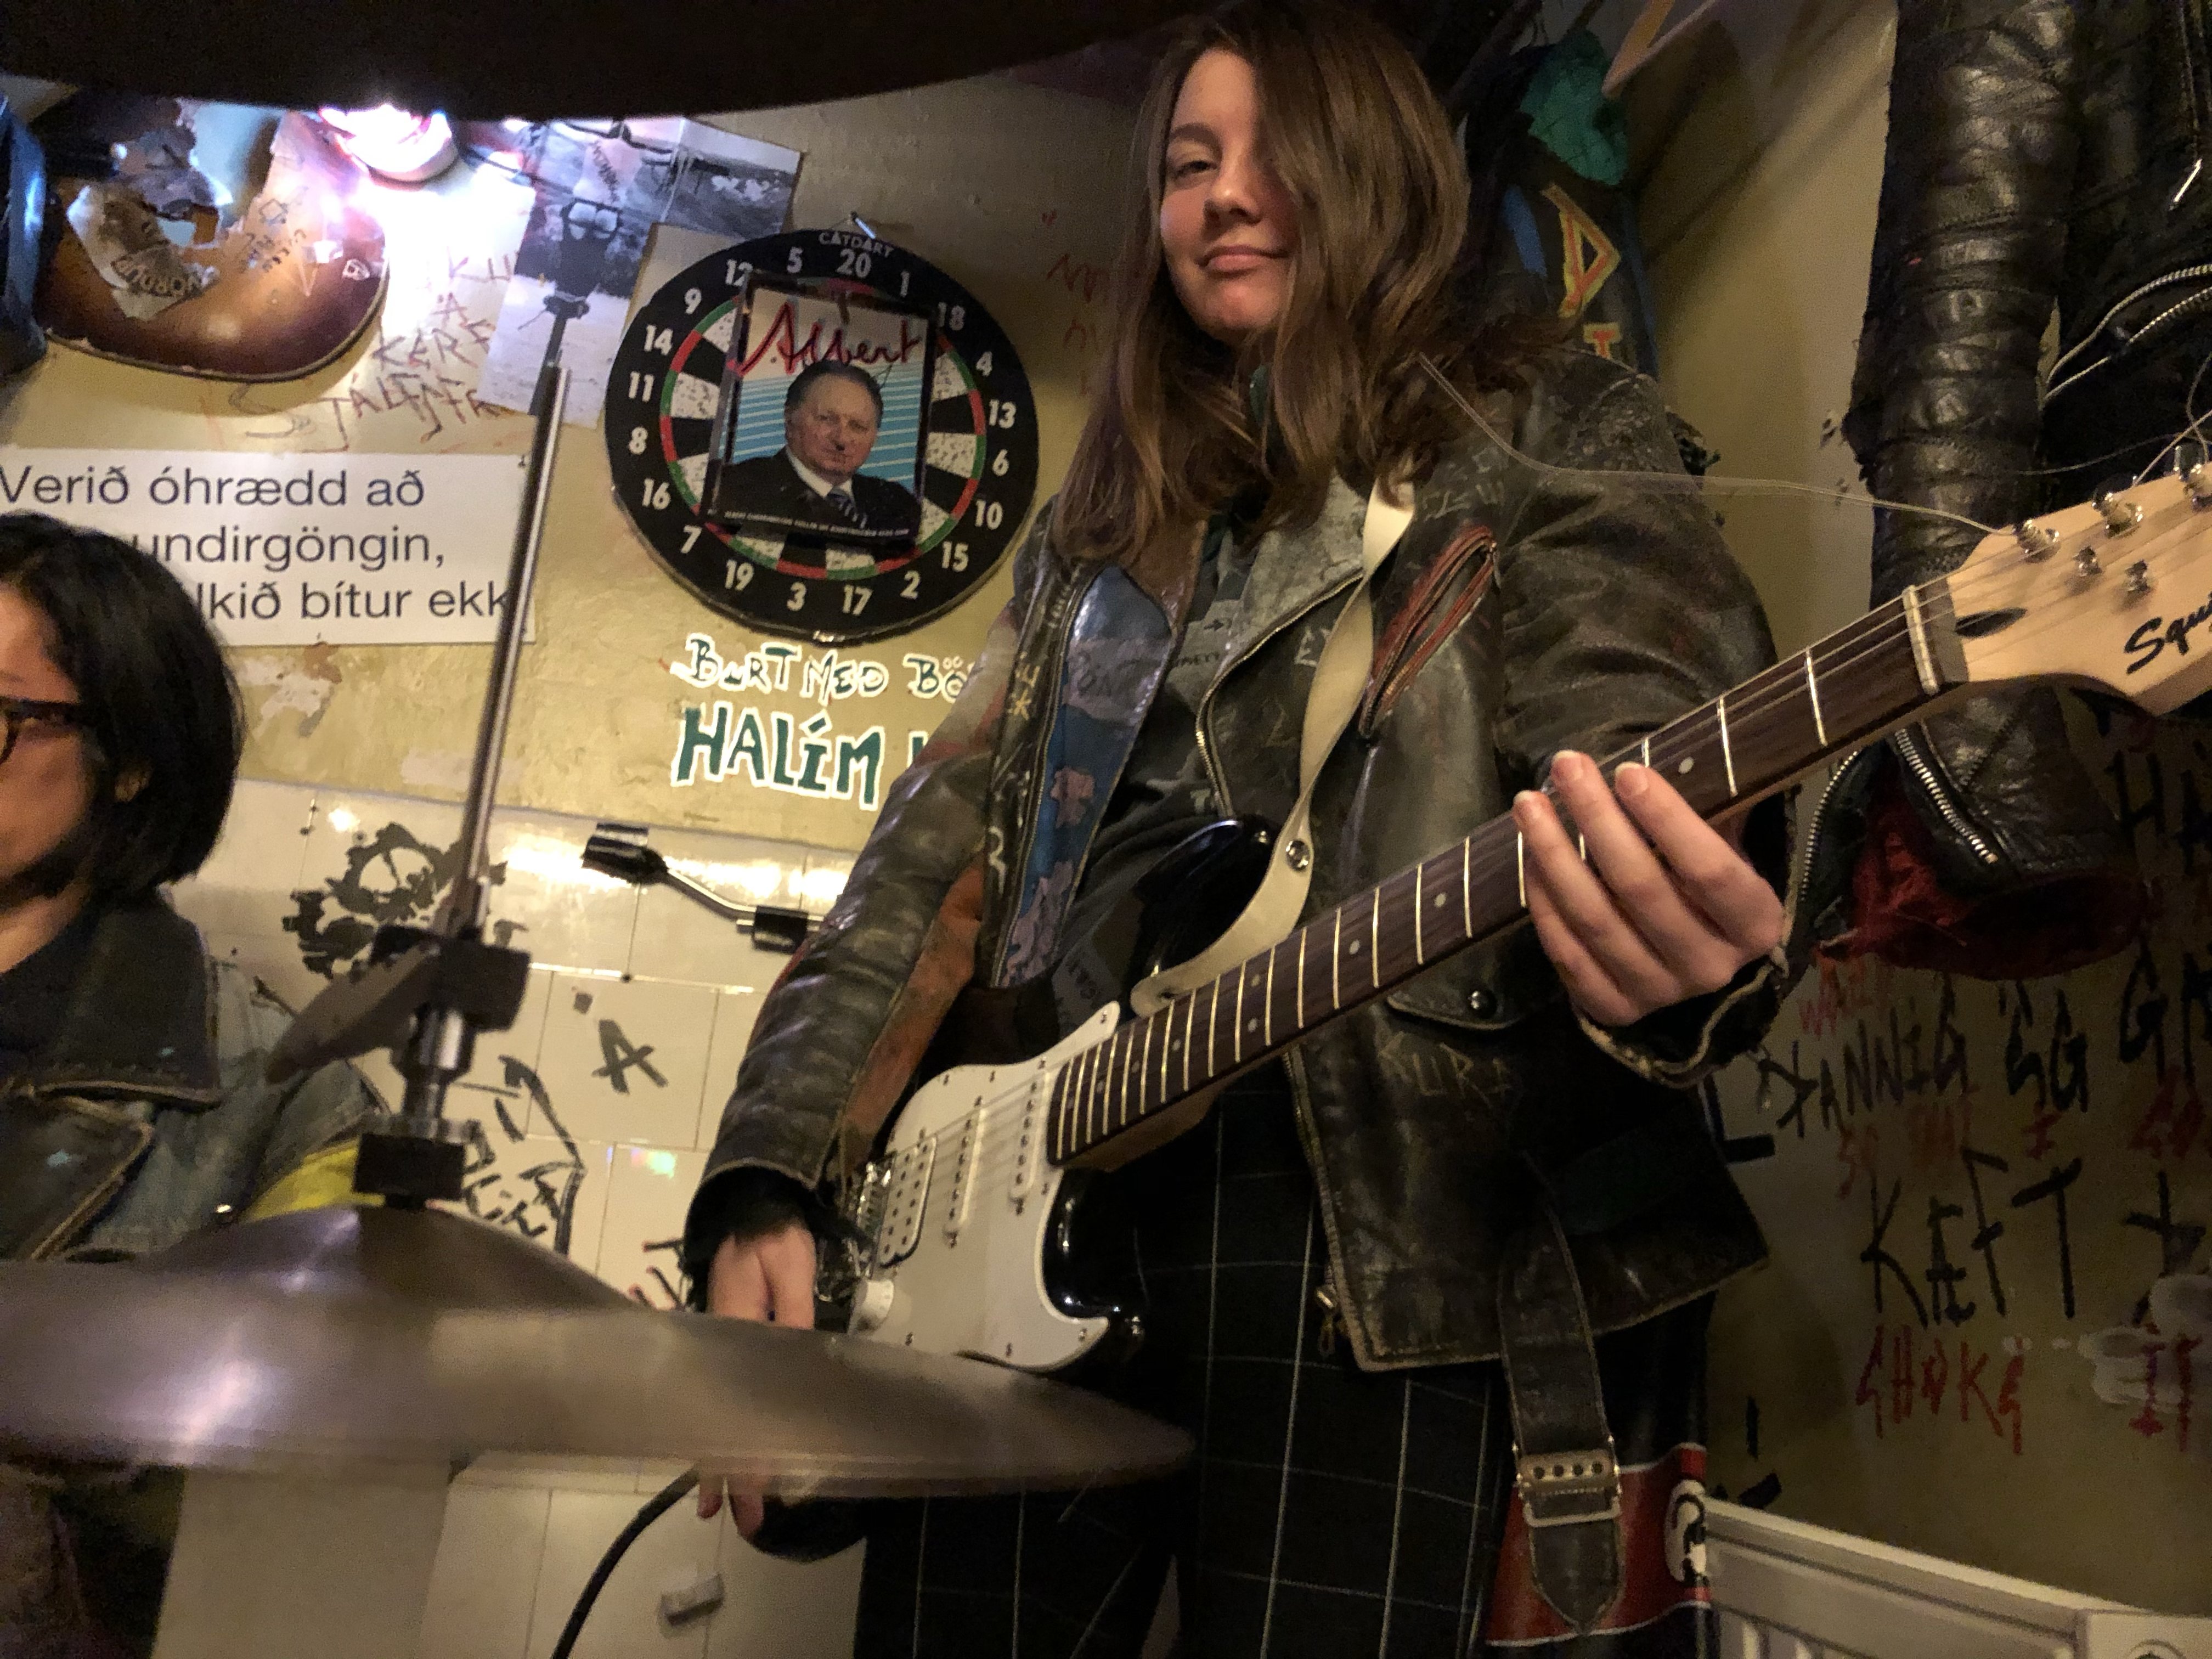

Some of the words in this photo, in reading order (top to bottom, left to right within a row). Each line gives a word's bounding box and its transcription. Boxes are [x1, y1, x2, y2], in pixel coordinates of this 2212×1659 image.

[726, 259, 751, 287] 12
[787, 247, 803, 273] 5
[836, 248, 873, 279] 20
[900, 271, 910, 296] 1
[685, 289, 701, 314] 9
[937, 302, 964, 329] 18
[645, 325, 672, 354] 14
[738, 300, 921, 377] Albert
[976, 352, 992, 376] 4
[629, 372, 653, 401] 11
[990, 400, 1016, 428] 13
[629, 427, 647, 454] 8
[993, 450, 1008, 476] 6
[0, 465, 129, 506] Verið
[149, 466, 347, 507] óhrædd
[366, 469, 425, 507] að
[643, 479, 670, 509] 16
[976, 500, 1002, 529] 10
[681, 526, 701, 553] 7
[943, 541, 968, 571] 15
[726, 560, 753, 590] 19
[901, 571, 919, 599] 2
[302, 580, 411, 620] bítur
[787, 583, 806, 611] 3
[843, 585, 871, 615] 17
[670, 700, 885, 812] HALÍM
